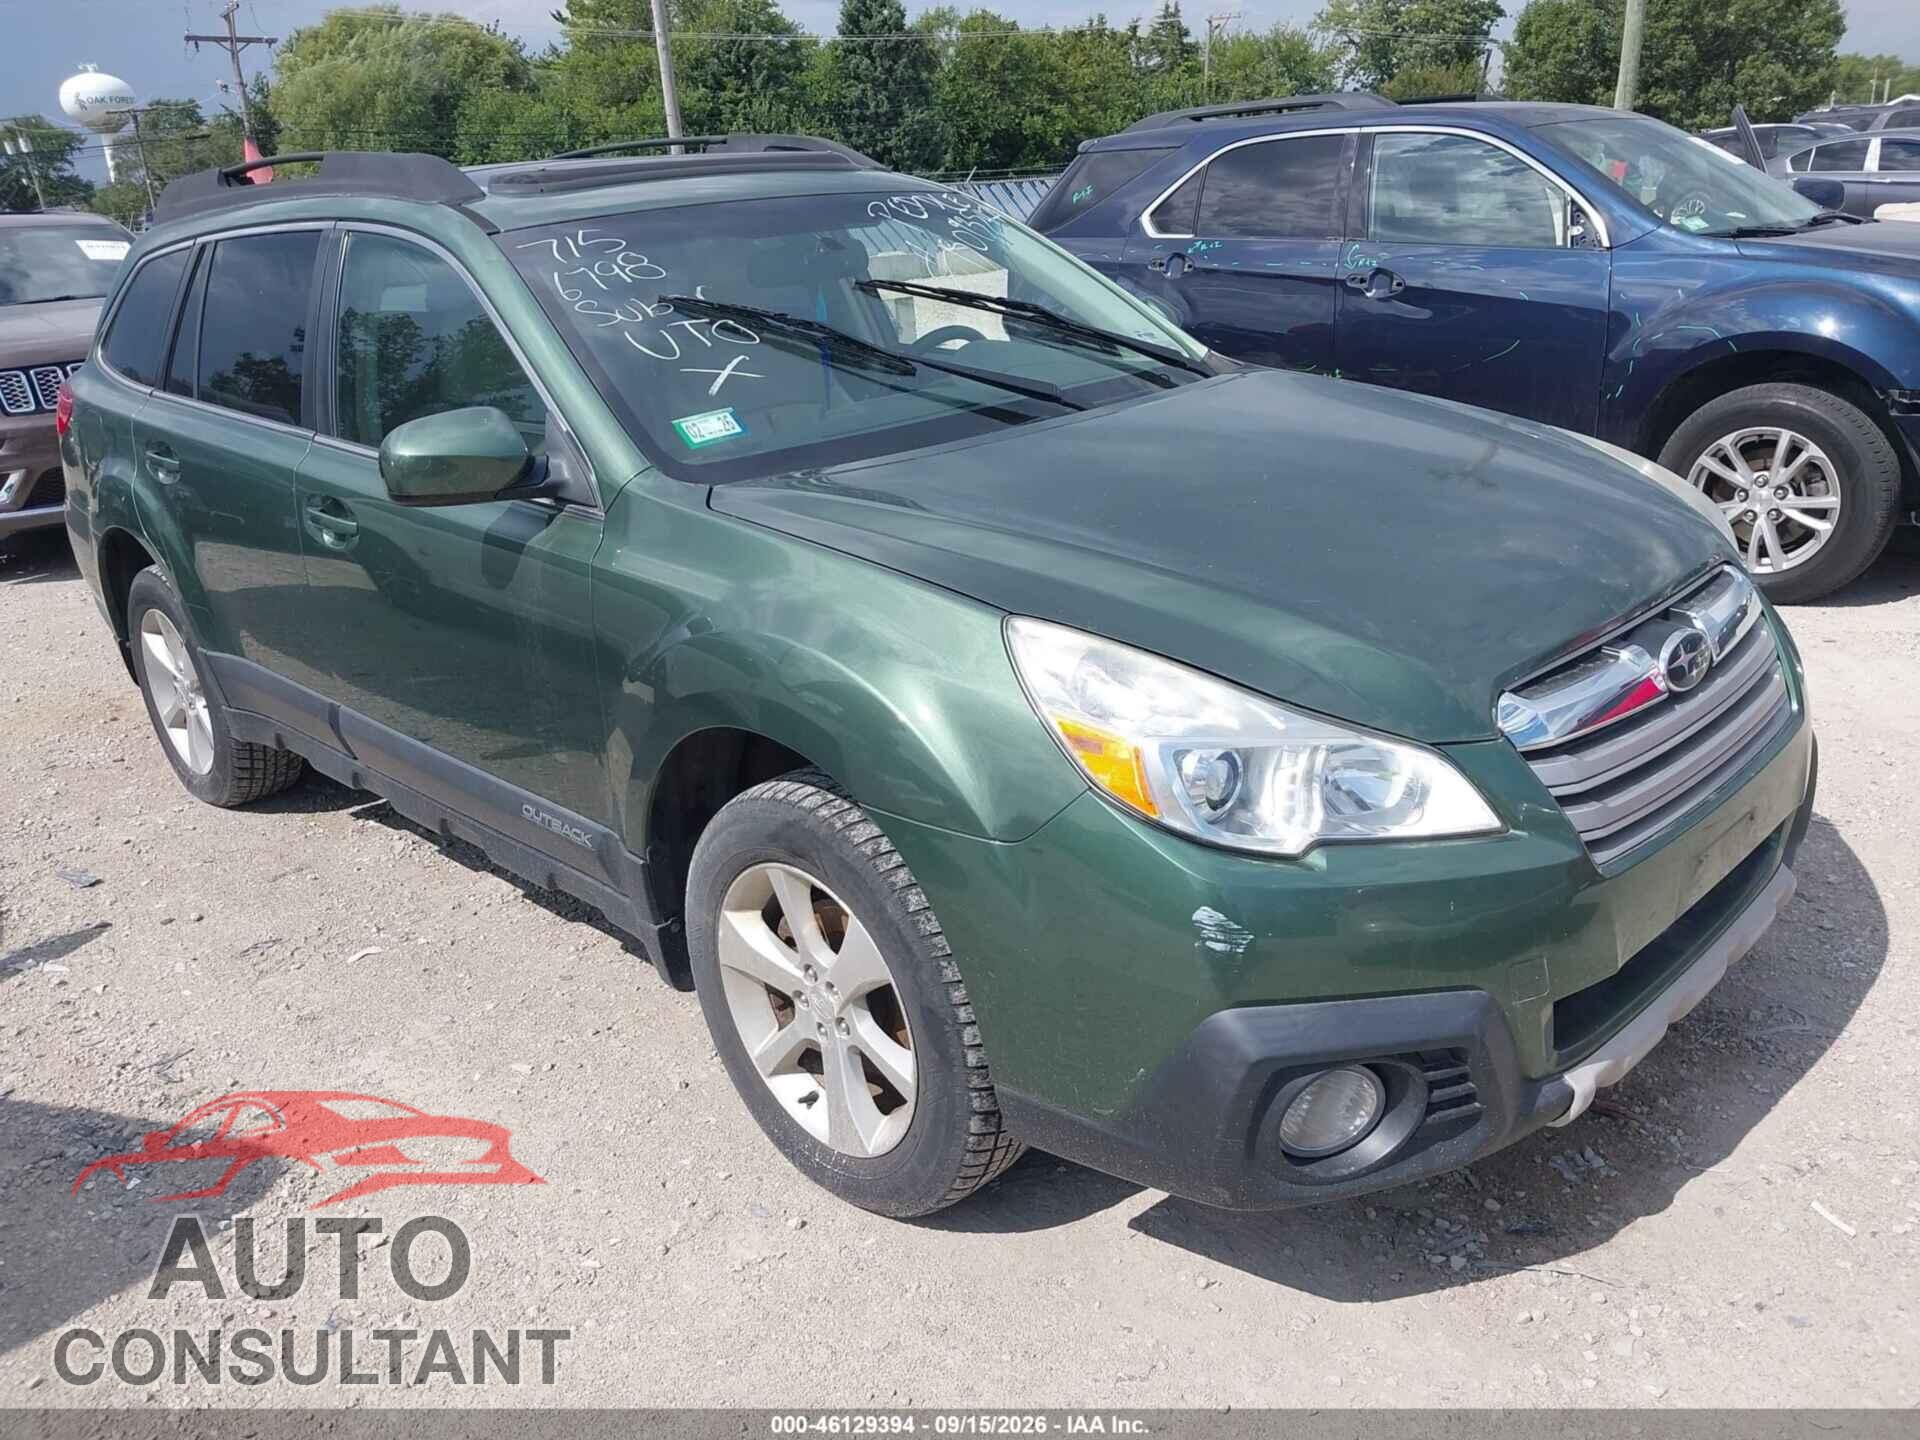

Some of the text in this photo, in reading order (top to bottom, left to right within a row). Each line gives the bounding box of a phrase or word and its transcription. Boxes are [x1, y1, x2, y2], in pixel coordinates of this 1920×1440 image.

[86, 95, 107, 105] OAK
[516, 229, 627, 264] 715
[522, 803, 593, 849] OUTBACK
